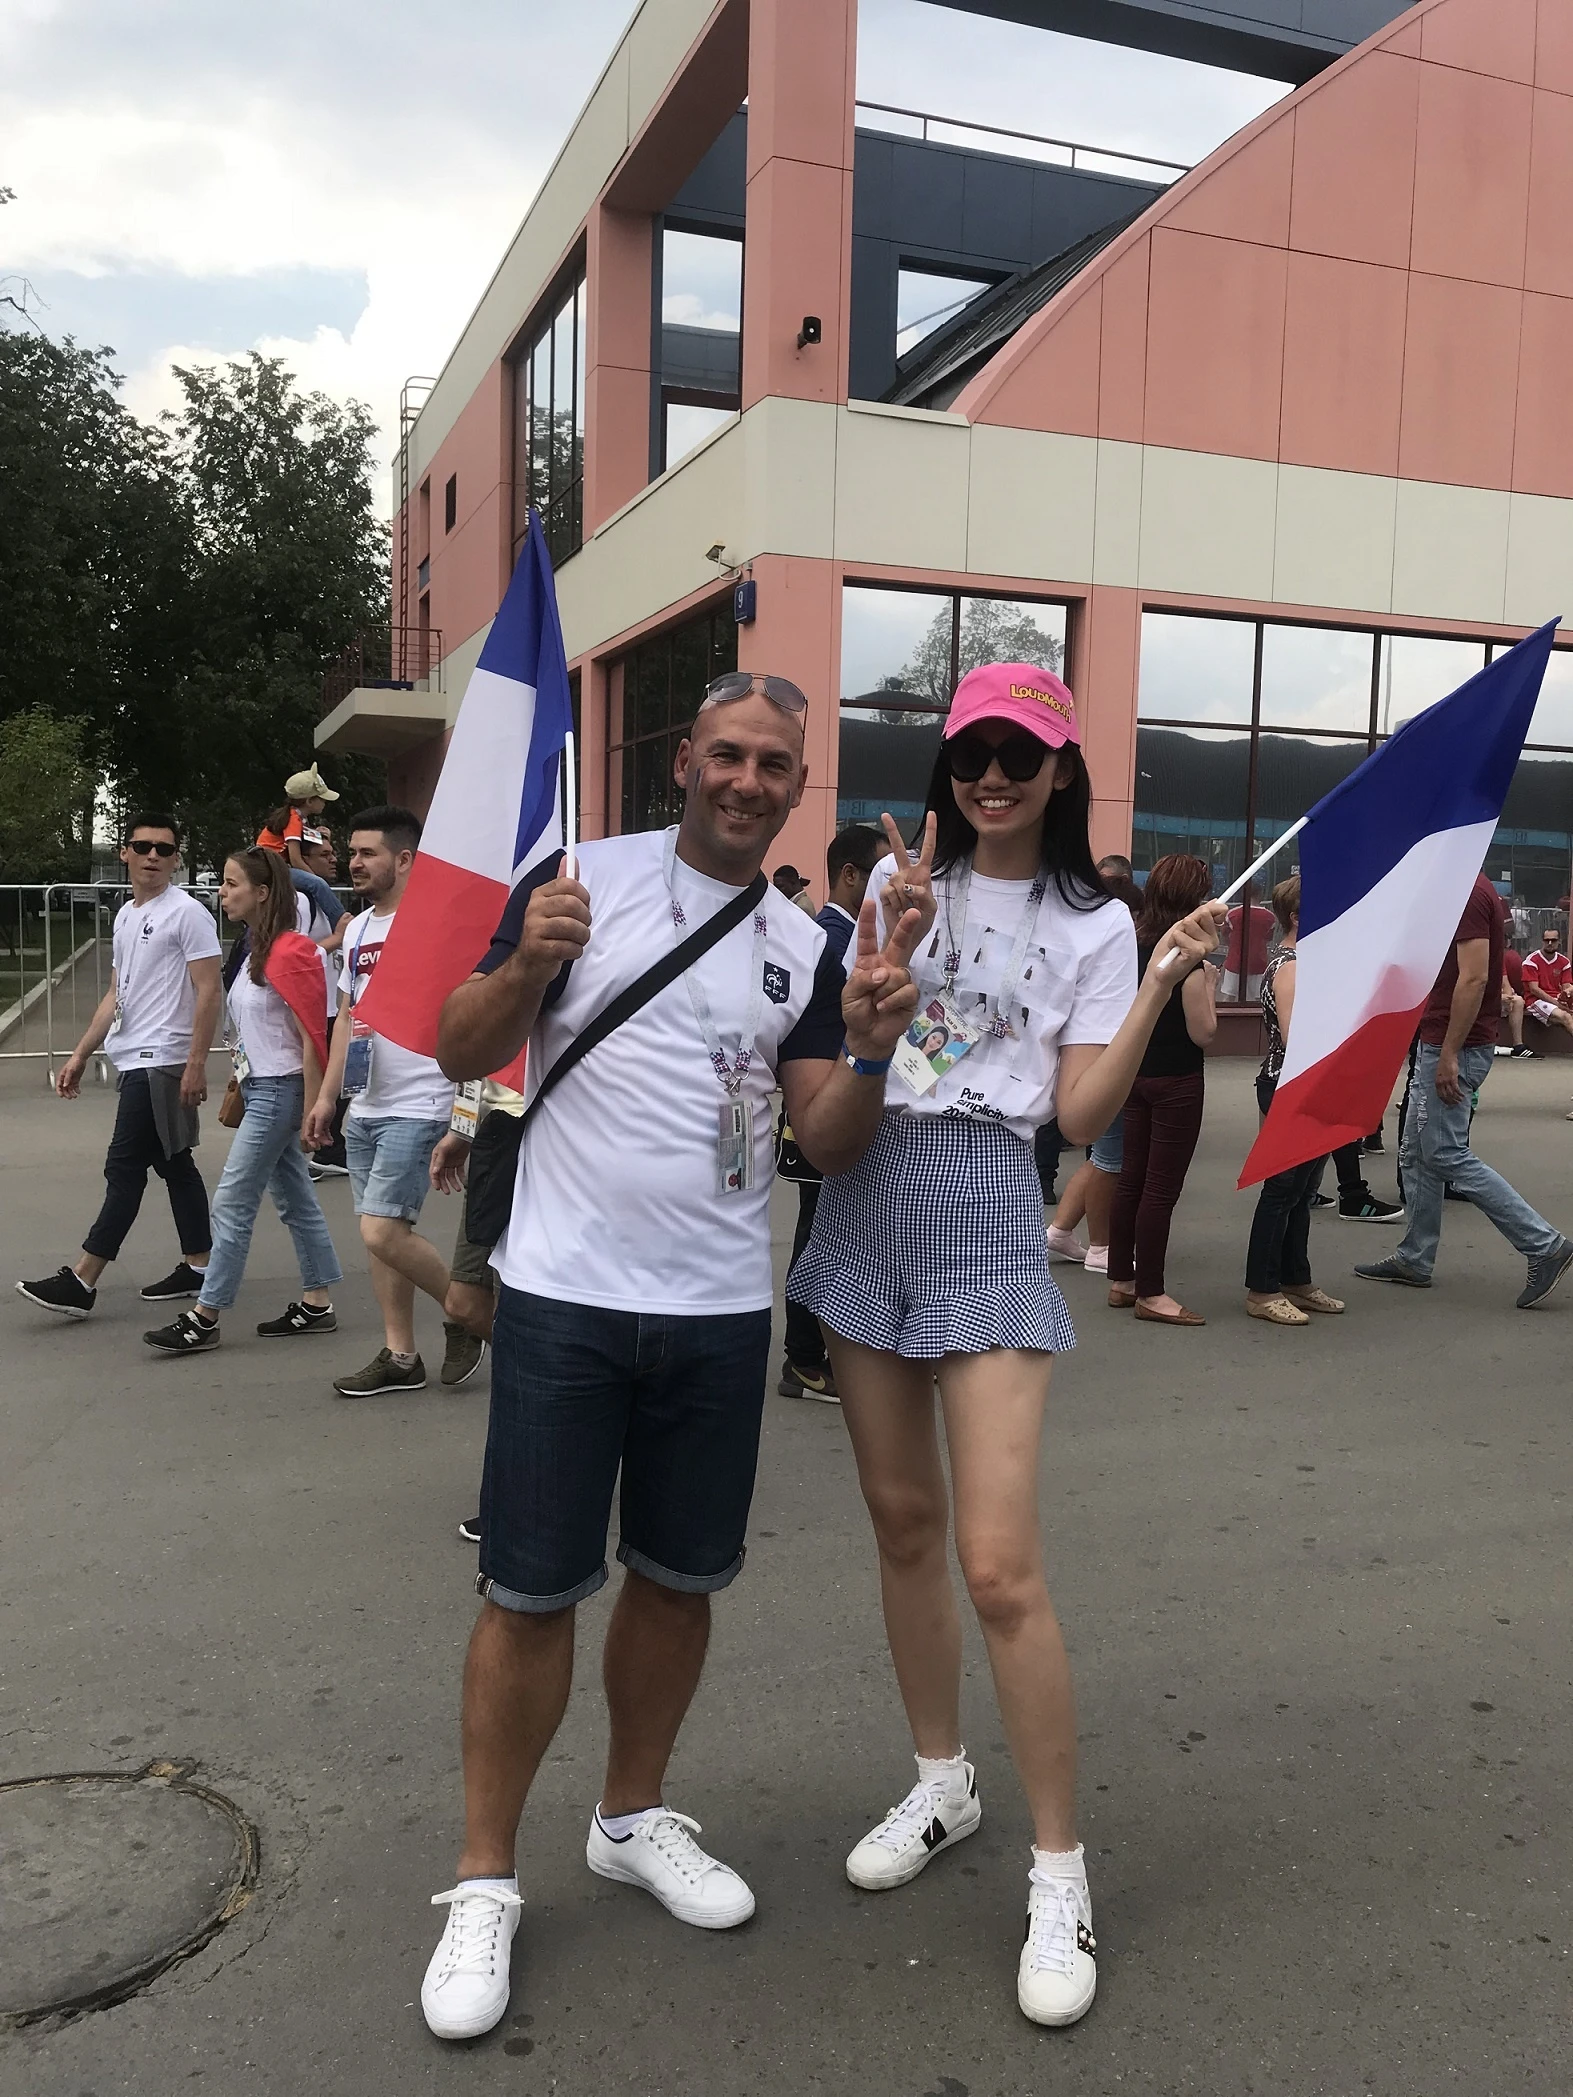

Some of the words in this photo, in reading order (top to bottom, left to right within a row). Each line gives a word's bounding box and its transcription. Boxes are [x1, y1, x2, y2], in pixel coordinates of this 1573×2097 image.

[738, 590, 744, 609] 9
[960, 1087, 985, 1101] Pure
[290, 1314, 307, 1328] N
[183, 1330, 200, 1344] N
